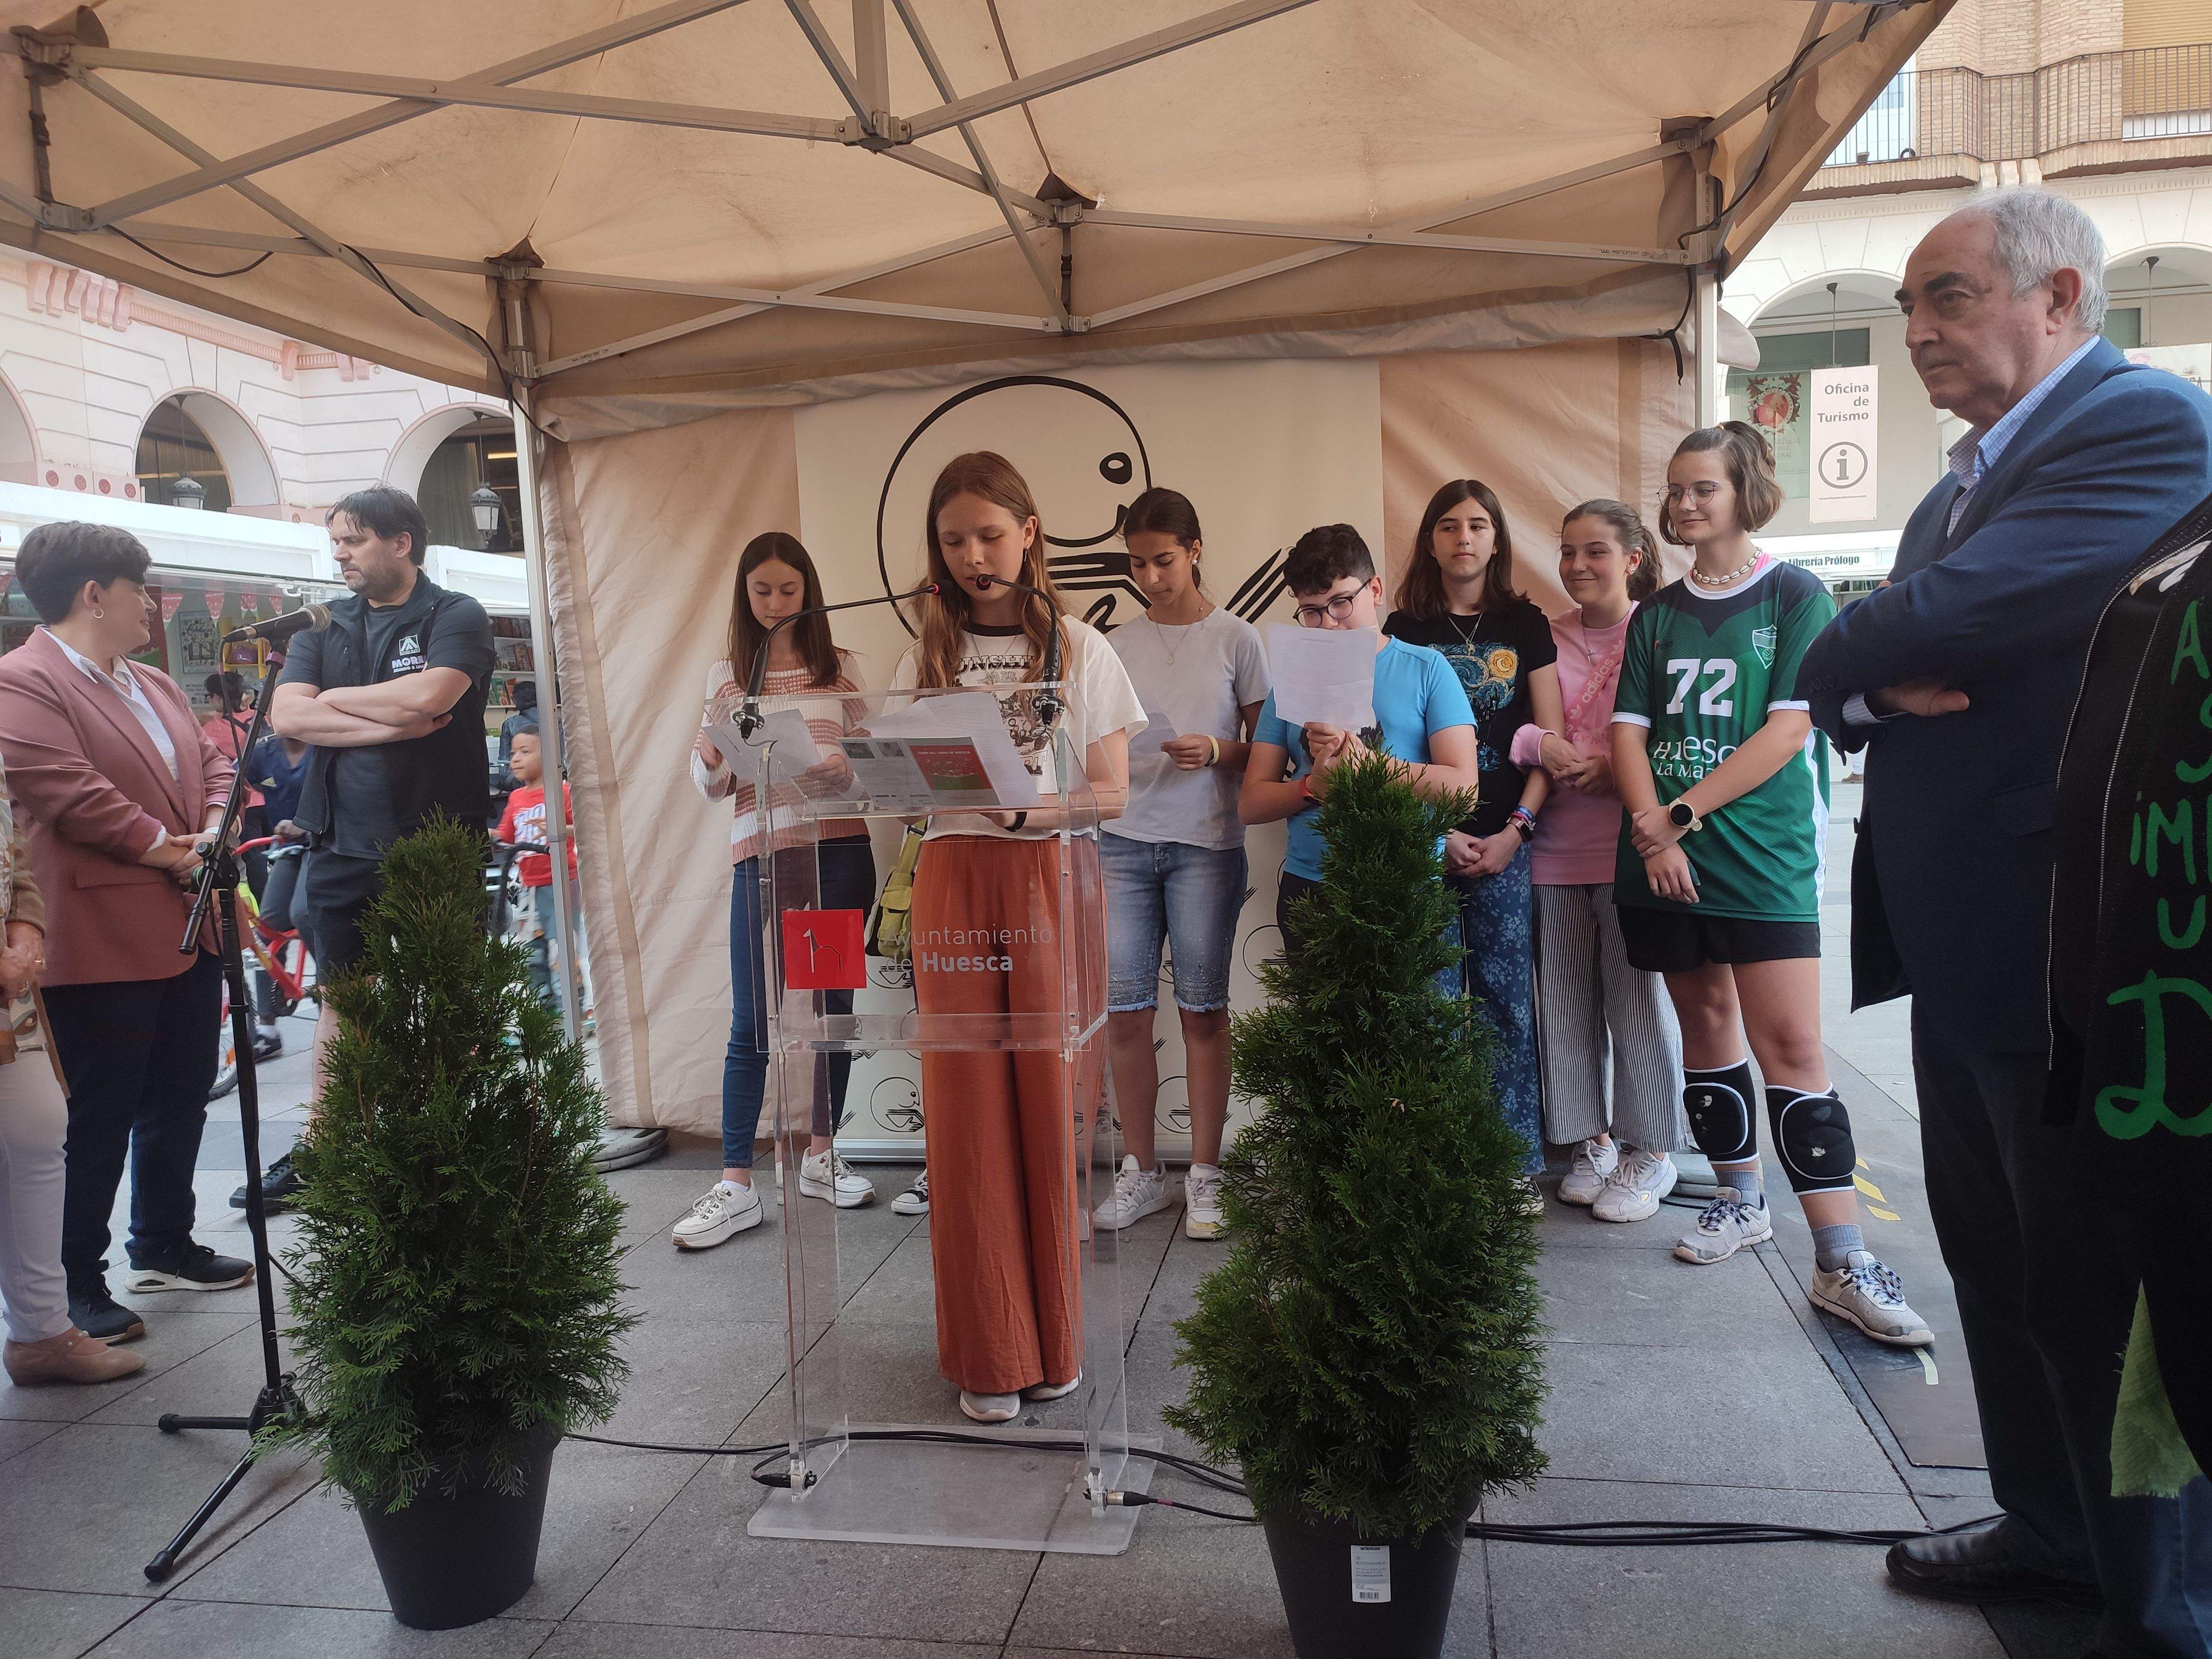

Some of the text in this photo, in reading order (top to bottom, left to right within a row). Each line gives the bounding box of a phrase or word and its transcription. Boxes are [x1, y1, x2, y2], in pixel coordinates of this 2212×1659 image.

[1824, 382, 1870, 395] Oficina
[1853, 395, 1870, 407] de
[1817, 411, 1870, 424] Turismo
[1788, 555, 1860, 567] Librería Prólogo
[1582, 658, 1614, 703] adidas
[1666, 658, 1738, 718] 72
[1652, 736, 1738, 764] Huesc
[1656, 762, 1673, 776] La
[884, 924, 1052, 952] Ayuntamiento
[885, 952, 1014, 973] de Huesca
